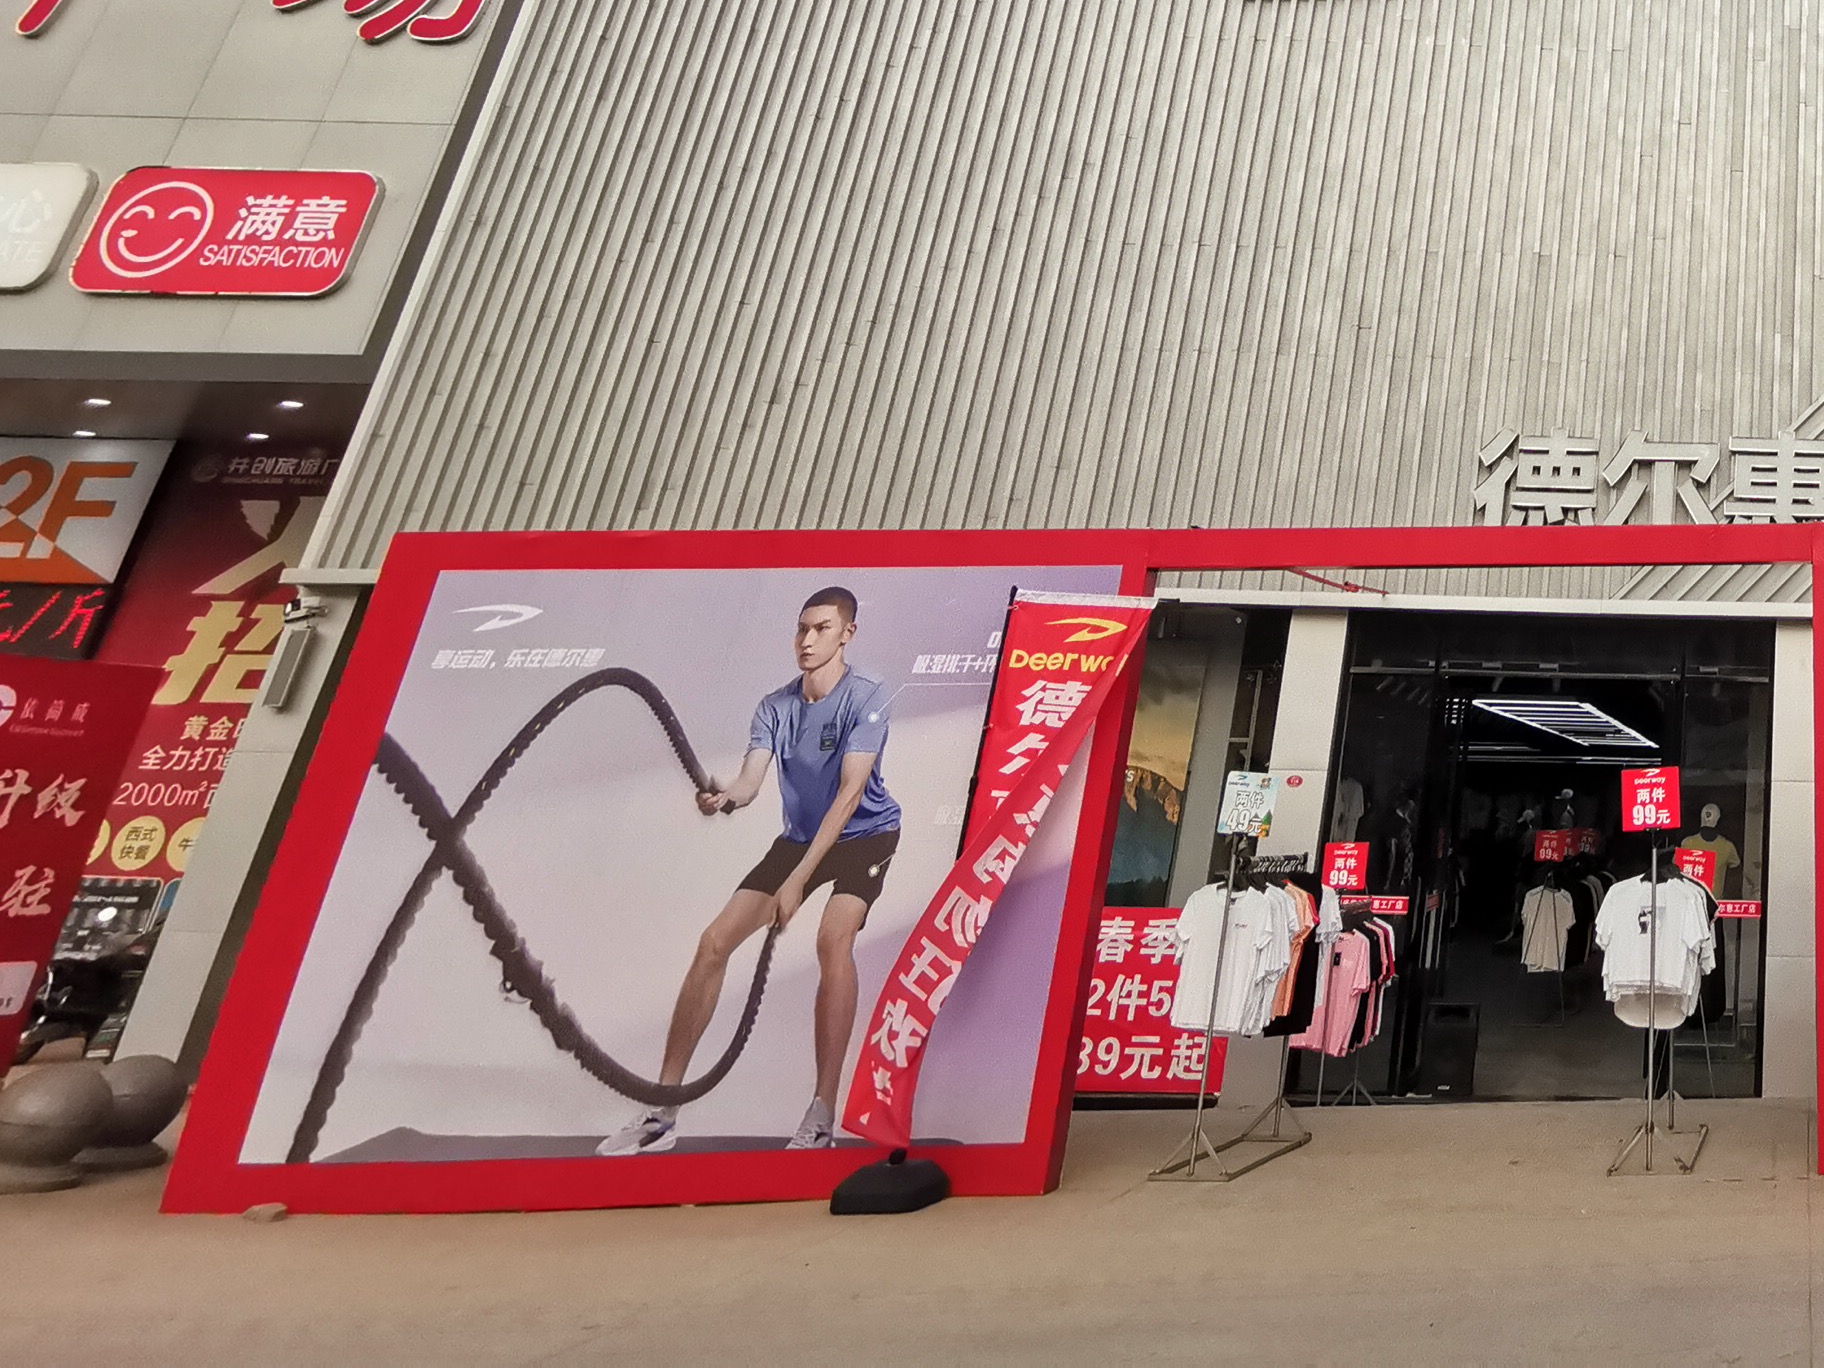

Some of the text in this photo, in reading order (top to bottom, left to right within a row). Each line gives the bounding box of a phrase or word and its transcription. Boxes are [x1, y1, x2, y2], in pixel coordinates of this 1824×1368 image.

[225, 195, 347, 241] 满意
[199, 244, 345, 268] SATISFACTION
[1235, 791, 1264, 809] 两件
[1636, 787, 1666, 803] 两件
[1226, 809, 1262, 832] 49元
[1632, 804, 1671, 825] 99元
[1334, 858, 1357, 870] 两件
[1683, 863, 1704, 877] 两件
[1329, 870, 1358, 886] 99元
